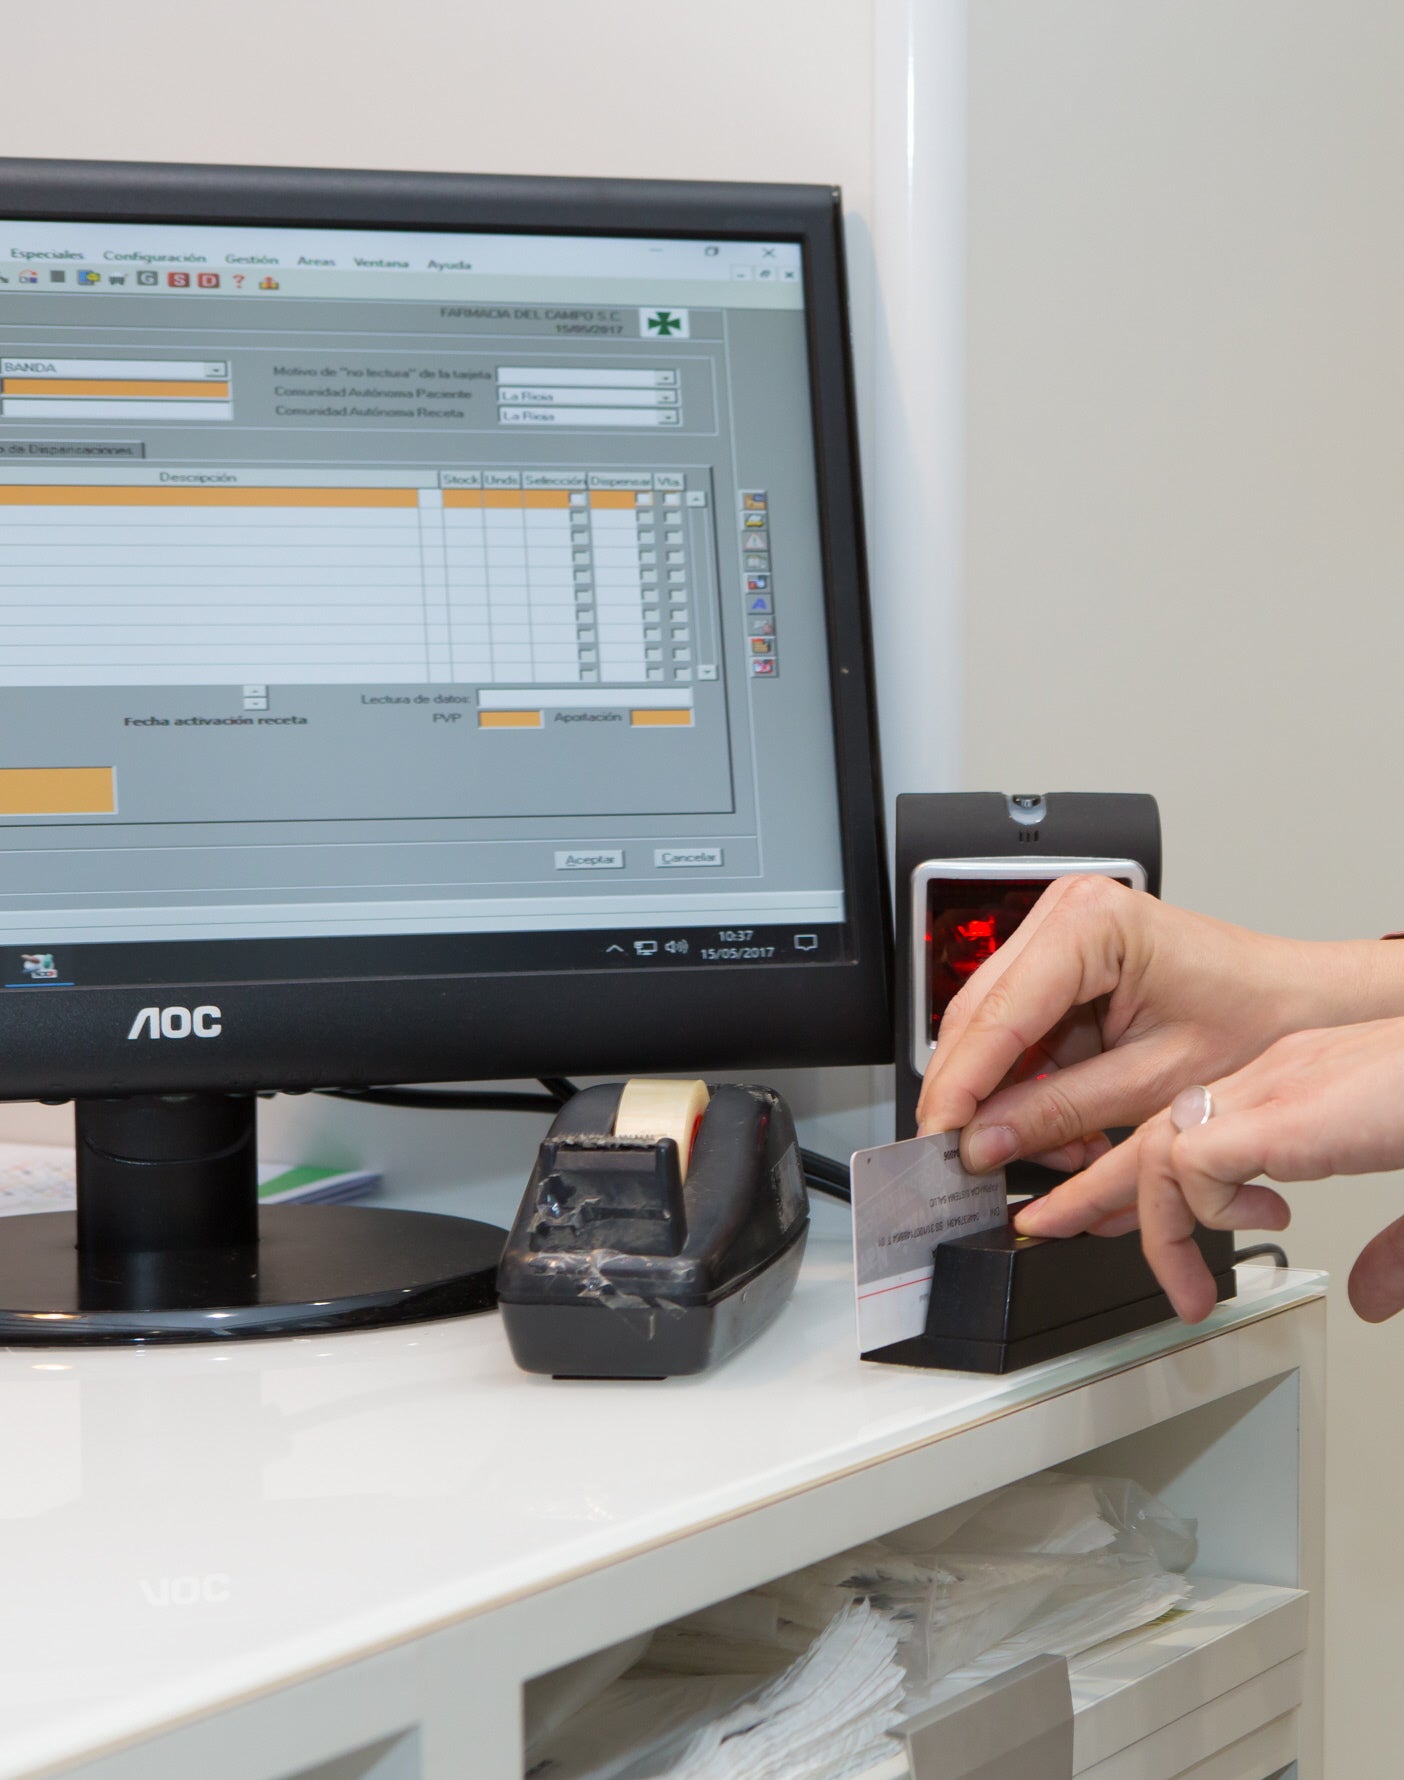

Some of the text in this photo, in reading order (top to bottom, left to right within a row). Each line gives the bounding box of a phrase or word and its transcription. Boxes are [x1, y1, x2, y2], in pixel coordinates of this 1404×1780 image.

[10, 248, 85, 261] Especiales
[103, 250, 207, 264] Configuración
[224, 253, 279, 265] Gestión
[354, 257, 410, 269] Ventana
[427, 259, 472, 271] Ayuda
[440, 307, 511, 320] FARMACIA
[514, 308, 541, 320] DEL
[545, 309, 594, 321] CAMPO
[555, 324, 624, 335] 15/05/2017
[4, 361, 57, 373] BANDA
[273, 366, 317, 377] Motivo
[320, 367, 337, 377] de
[419, 369, 436, 379] de
[438, 370, 451, 380] la
[452, 370, 492, 381] tarjeta
[274, 386, 472, 399] Comunidad Autónoma Paciente
[502, 391, 554, 402] La Rioja
[275, 405, 465, 418] Comunidad Autónoma Receta
[503, 411, 555, 422] La Rioja
[28, 444, 134, 456] Dispensaciones
[159, 471, 238, 484] Descripción
[443, 474, 479, 486] Stock
[485, 475, 518, 486] Unds
[525, 475, 586, 487] Selección
[361, 694, 411, 704] Lectura
[413, 694, 431, 704] de
[124, 715, 308, 727] Fecha activación receta
[433, 712, 462, 723] PVP
[554, 712, 622, 724] Aportación
[565, 855, 615, 867] Aceptar
[662, 852, 717, 865] Cancelar
[719, 930, 754, 942] 10:37
[701, 947, 776, 960] 15/05/2017
[127, 1005, 223, 1040] AOC
